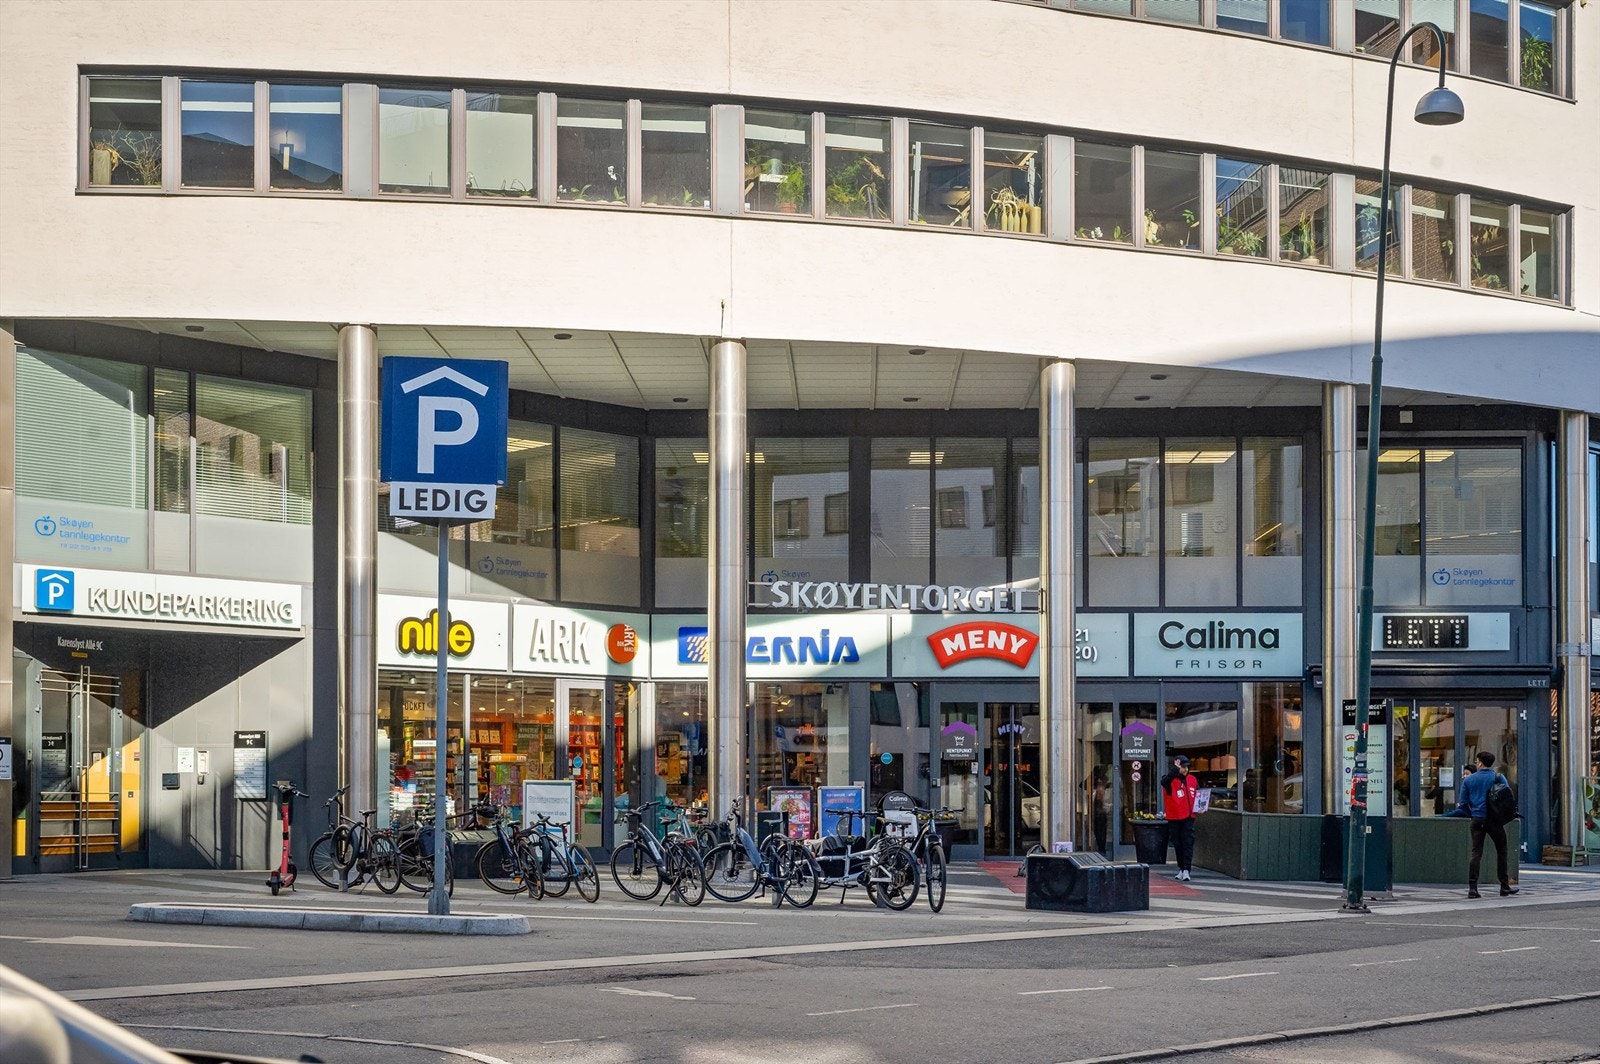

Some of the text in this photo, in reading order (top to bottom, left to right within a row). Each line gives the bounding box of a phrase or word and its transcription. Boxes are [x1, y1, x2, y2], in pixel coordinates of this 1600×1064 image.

[417, 395, 480, 474] P
[398, 487, 488, 513] LEDIG
[60, 516, 94, 529] Skøyen
[59, 530, 130, 543] tannlegekontor
[781, 570, 811, 579] Skøyen
[1452, 567, 1483, 577] Skøyen
[1453, 577, 1516, 587] tannlegekontor
[49, 582, 64, 605] P
[88, 586, 294, 622] KUNDEPARKERING
[771, 580, 1027, 613] SKØYENTORGET
[400, 609, 474, 656] nile
[529, 618, 590, 663] ARK
[940, 629, 1028, 656] MENY
[1158, 620, 1280, 650] Calima
[1386, 618, 1466, 645] LETT
[746, 628, 860, 663] ERNIA
[1175, 659, 1262, 669] FRISØR
[1527, 679, 1547, 687] LETT
[404, 701, 426, 711] OCKET
[997, 723, 1026, 736] MENY
